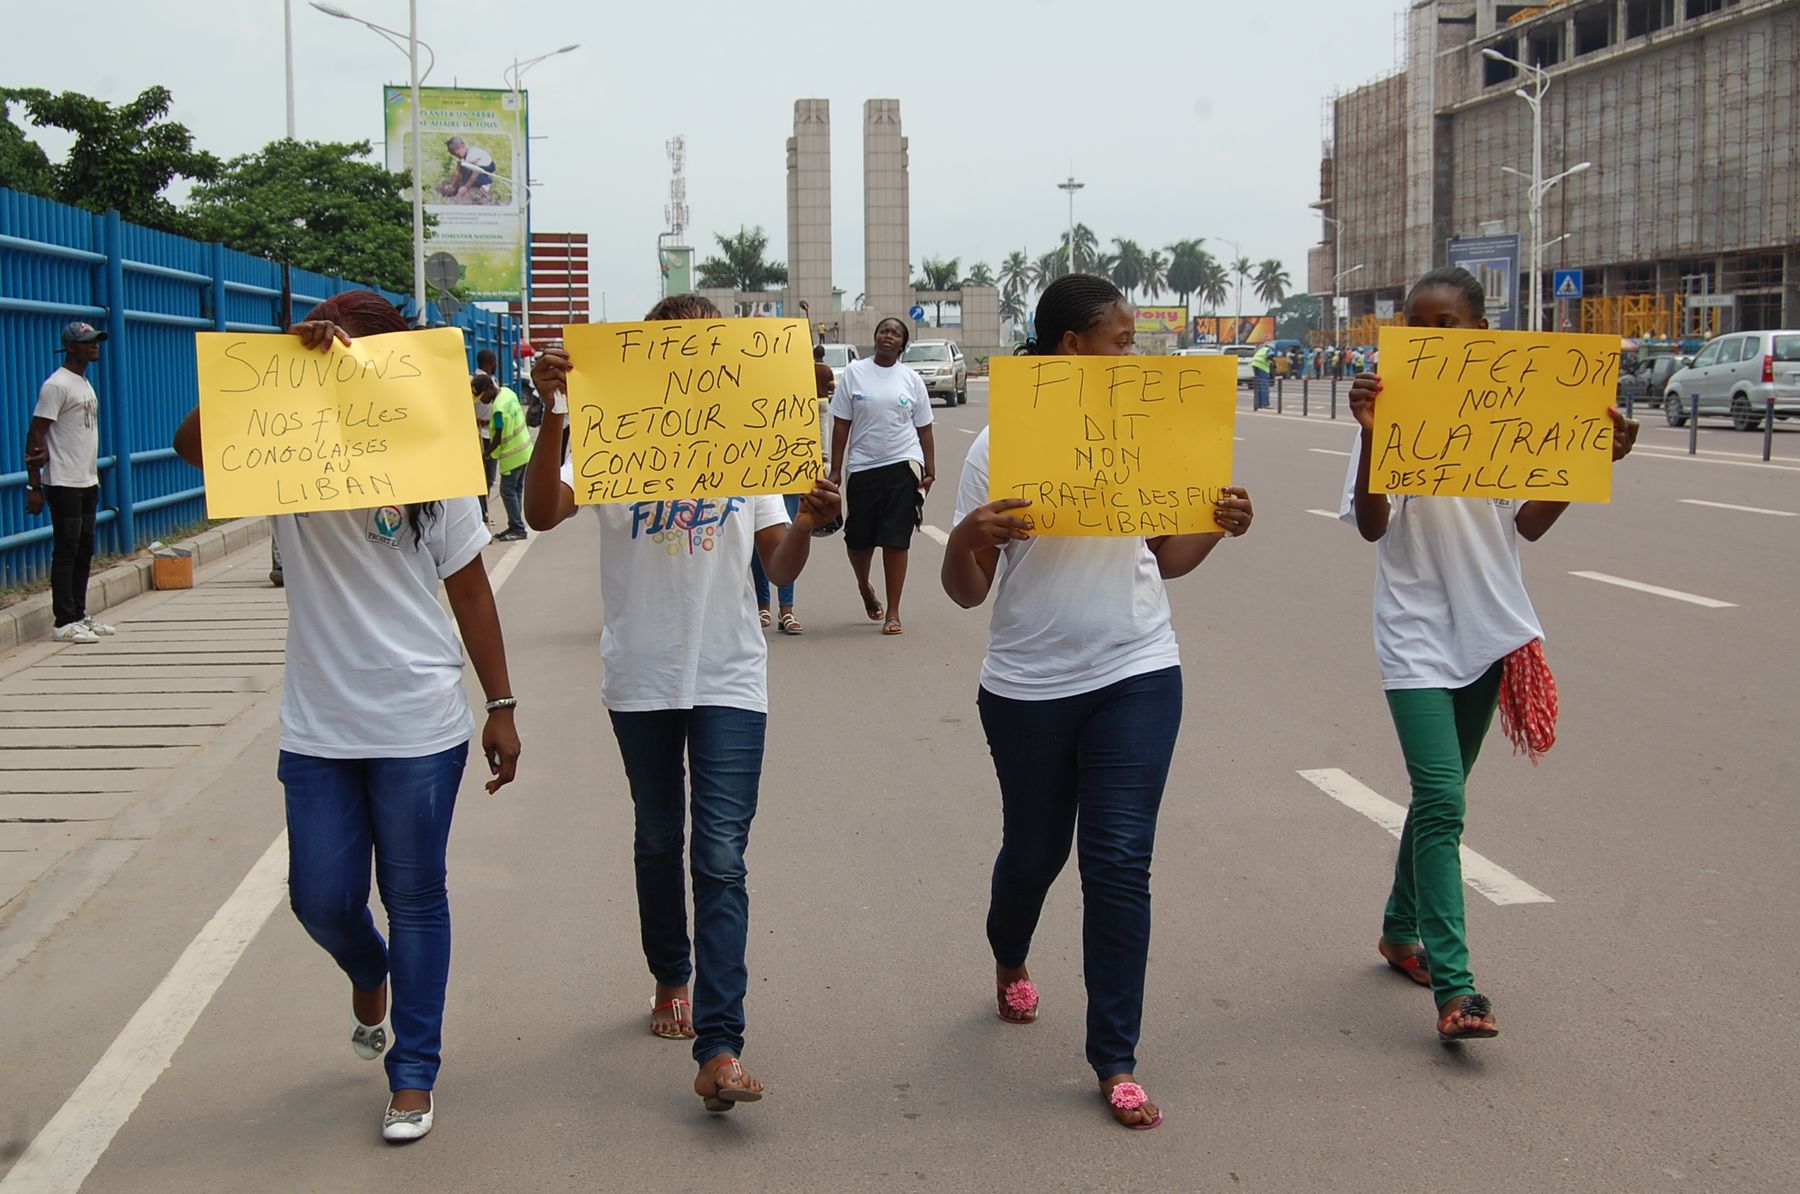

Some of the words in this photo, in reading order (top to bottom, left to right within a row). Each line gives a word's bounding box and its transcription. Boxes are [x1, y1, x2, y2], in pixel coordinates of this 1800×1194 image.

[616, 326, 727, 363] FIFEF
[741, 325, 798, 358] DIT
[1407, 336, 1551, 384] FIFEF
[220, 341, 422, 393] SAUVONS
[664, 364, 742, 404] NON
[1030, 361, 1206, 409] FIFEF
[1458, 386, 1526, 418] NON
[247, 408, 303, 437] NOS
[581, 404, 726, 447] RETOUR
[743, 394, 817, 428] SANS
[1083, 412, 1152, 443] DIT
[322, 458, 352, 476] AU
[1074, 445, 1142, 473] NON
[275, 472, 396, 506] LIBAN
[690, 471, 725, 494] AU
[1093, 466, 1130, 488] AU
[1137, 486, 1181, 508] DES
